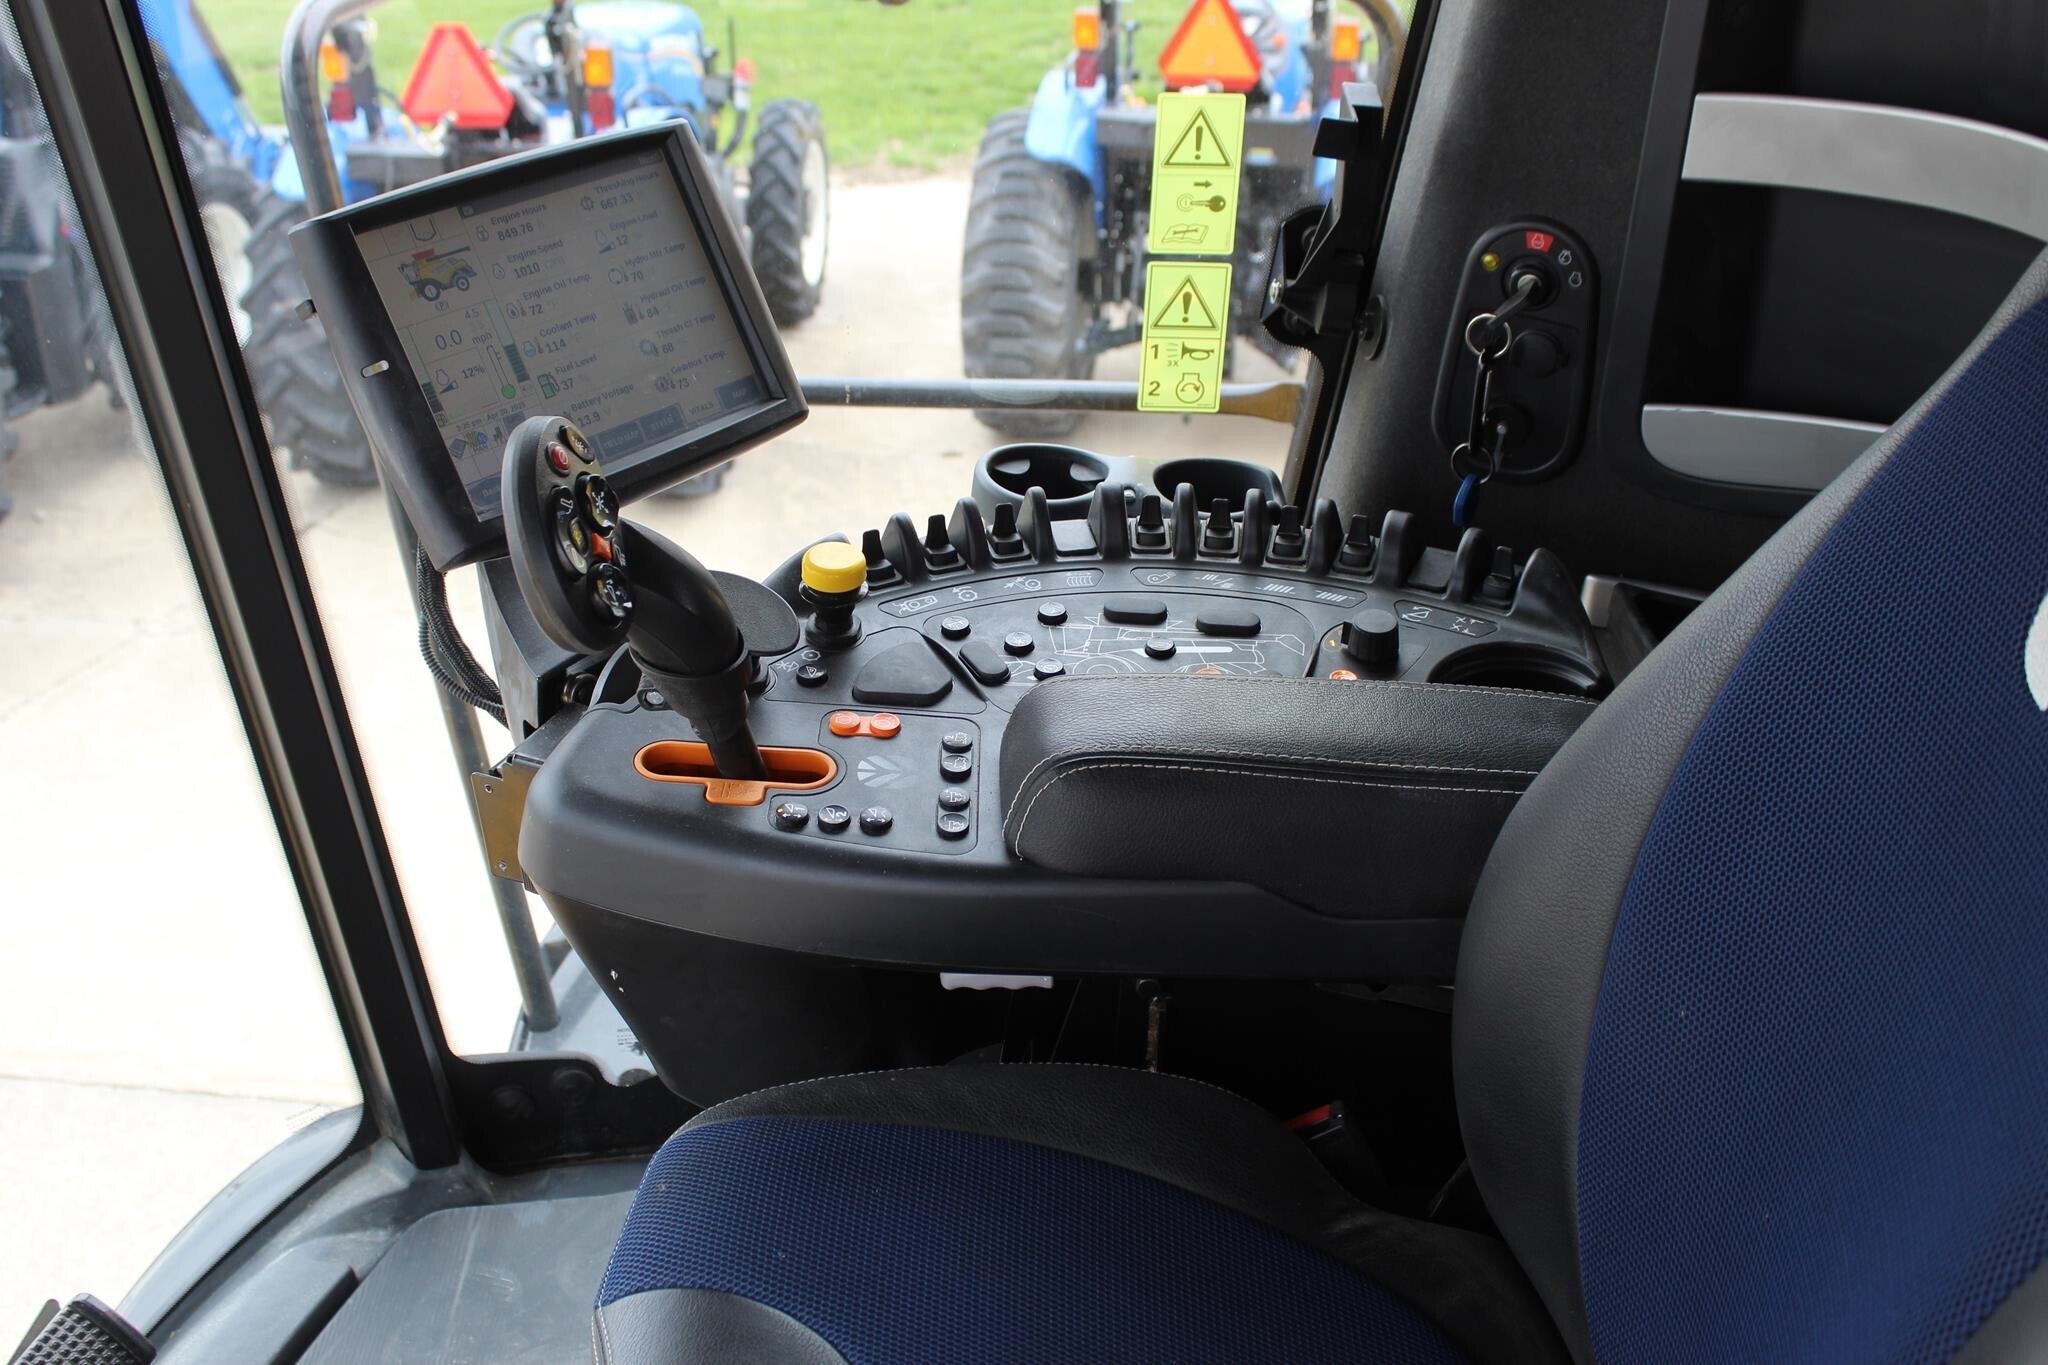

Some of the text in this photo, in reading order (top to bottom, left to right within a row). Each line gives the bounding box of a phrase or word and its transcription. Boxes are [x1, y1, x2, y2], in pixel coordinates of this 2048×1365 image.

[490, 211, 521, 226] Engine
[520, 202, 547, 217] Hours
[497, 222, 534, 241] 849.76
[609, 217, 637, 231] Engine
[616, 233, 629, 246] 12
[506, 238, 564, 263] Engine Speed
[514, 261, 541, 280] 1010
[631, 270, 645, 283] 70
[522, 285, 553, 301] Engine
[553, 278, 567, 291] Oil
[464, 308, 481, 320] 4.5
[529, 303, 544, 316] 72
[539, 319, 573, 338] Coolant
[573, 311, 598, 328] Temp
[434, 329, 462, 351] 0.0
[471, 331, 494, 345] mph
[545, 337, 567, 354] 114
[1151, 344, 1159, 360] 1
[555, 352, 598, 375] Fuel Level
[461, 364, 487, 380] 12%
[561, 377, 574, 391] 37
[677, 377, 690, 391] 73
[1148, 380, 1160, 396] 2
[569, 383, 634, 412] Battery Voltage
[577, 411, 601, 426] 13.9
